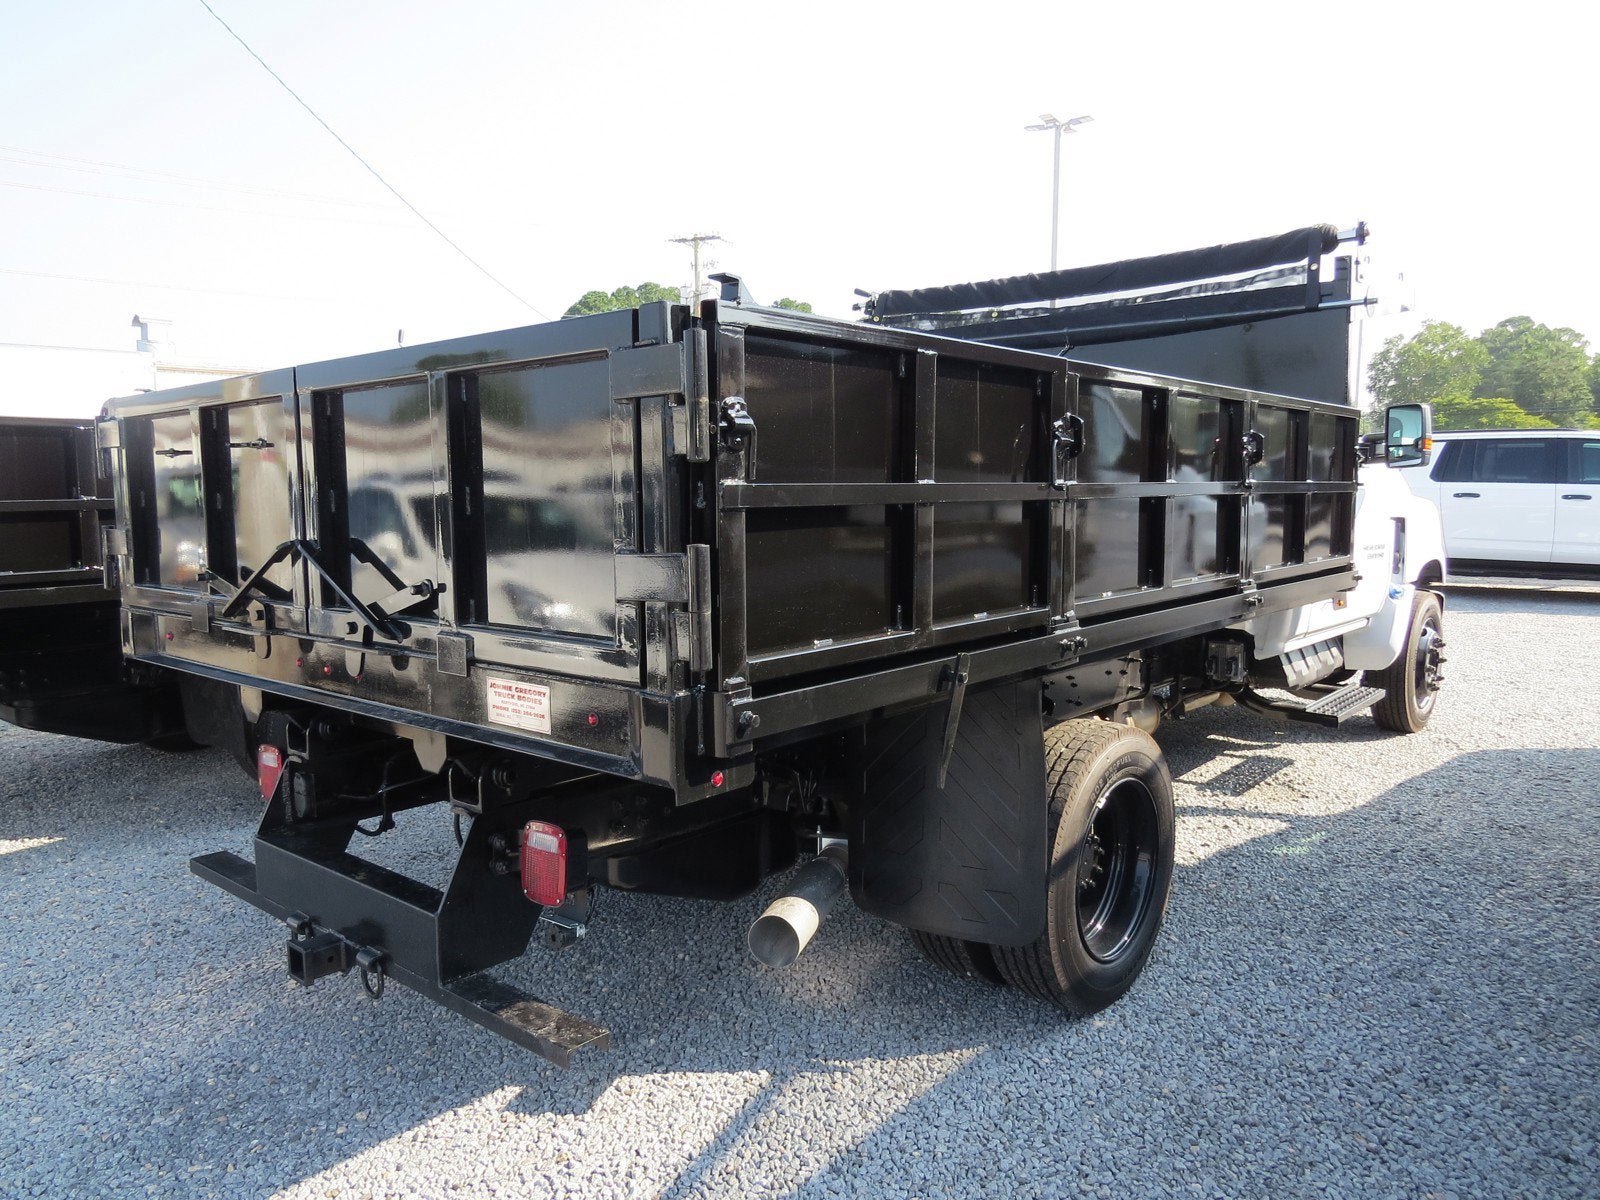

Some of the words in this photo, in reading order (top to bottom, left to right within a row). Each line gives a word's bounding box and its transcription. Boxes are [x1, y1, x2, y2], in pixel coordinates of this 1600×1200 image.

[494, 691, 515, 700] TRUCK
[517, 695, 542, 705] BODIES
[515, 687, 546, 698] GREGORY
